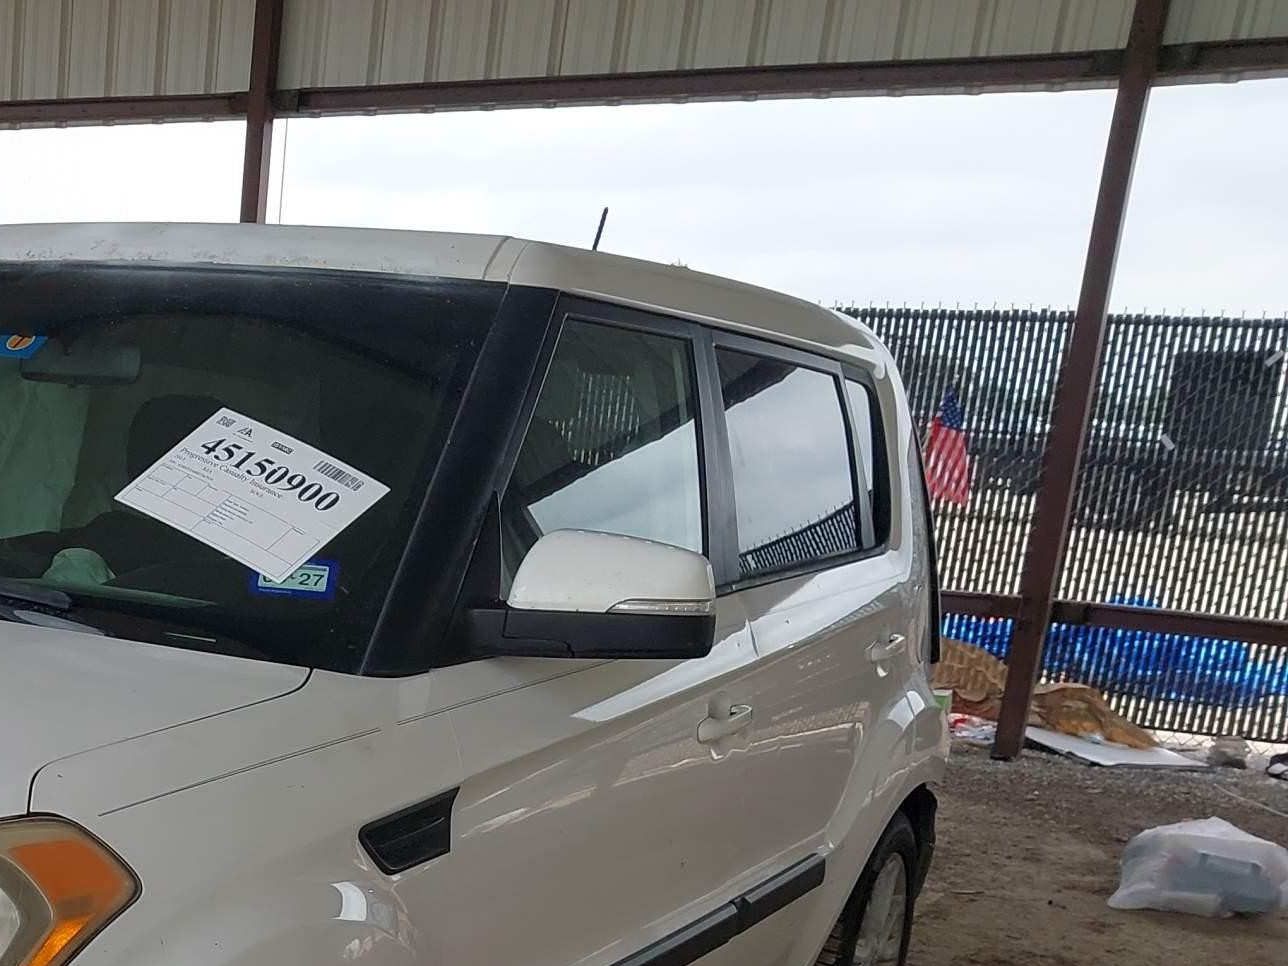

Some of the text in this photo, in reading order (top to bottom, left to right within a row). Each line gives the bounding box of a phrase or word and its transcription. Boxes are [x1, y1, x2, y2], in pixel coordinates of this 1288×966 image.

[200, 438, 340, 511] 45150900
[220, 463, 249, 482] Casualty
[249, 479, 284, 499] Insurance
